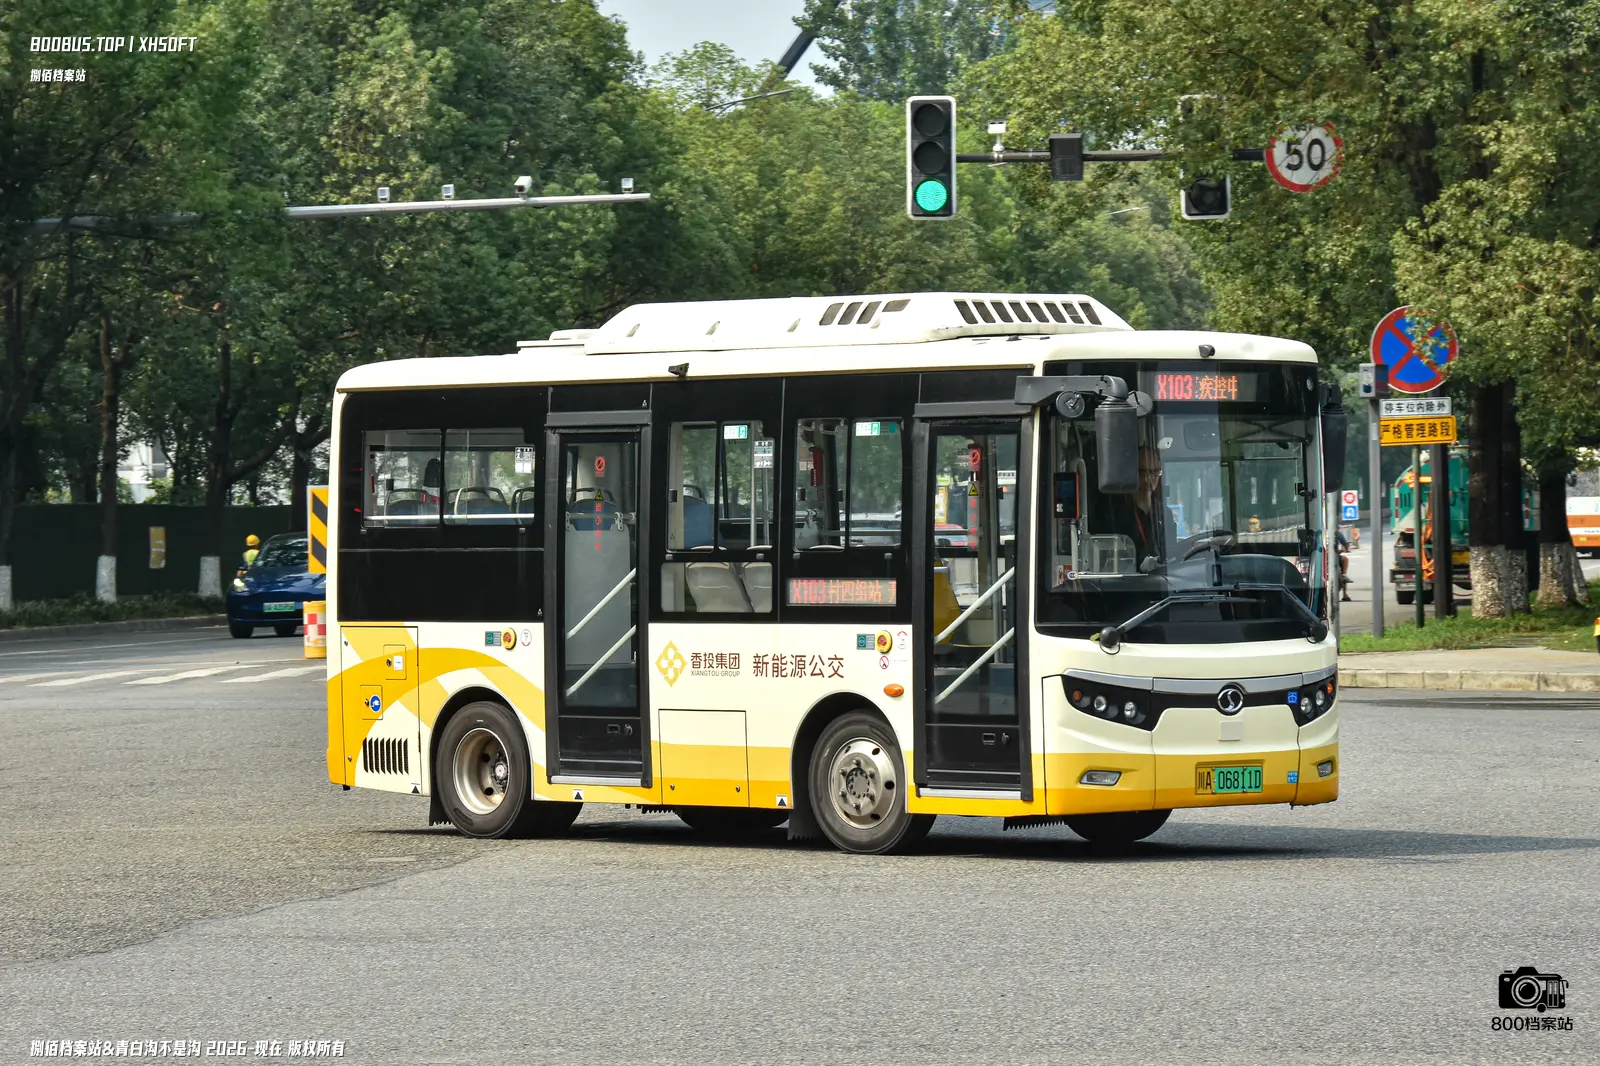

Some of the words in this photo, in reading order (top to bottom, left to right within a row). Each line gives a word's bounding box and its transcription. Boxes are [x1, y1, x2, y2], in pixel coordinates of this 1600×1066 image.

[1286, 138, 1326, 171] 50
[1158, 374, 1193, 400] X103
[1384, 402, 1447, 414] 停车位内除外
[690, 652, 740, 670] 香投集团
[752, 653, 845, 679] 新能源公交
[720, 670, 741, 678] GROUP
